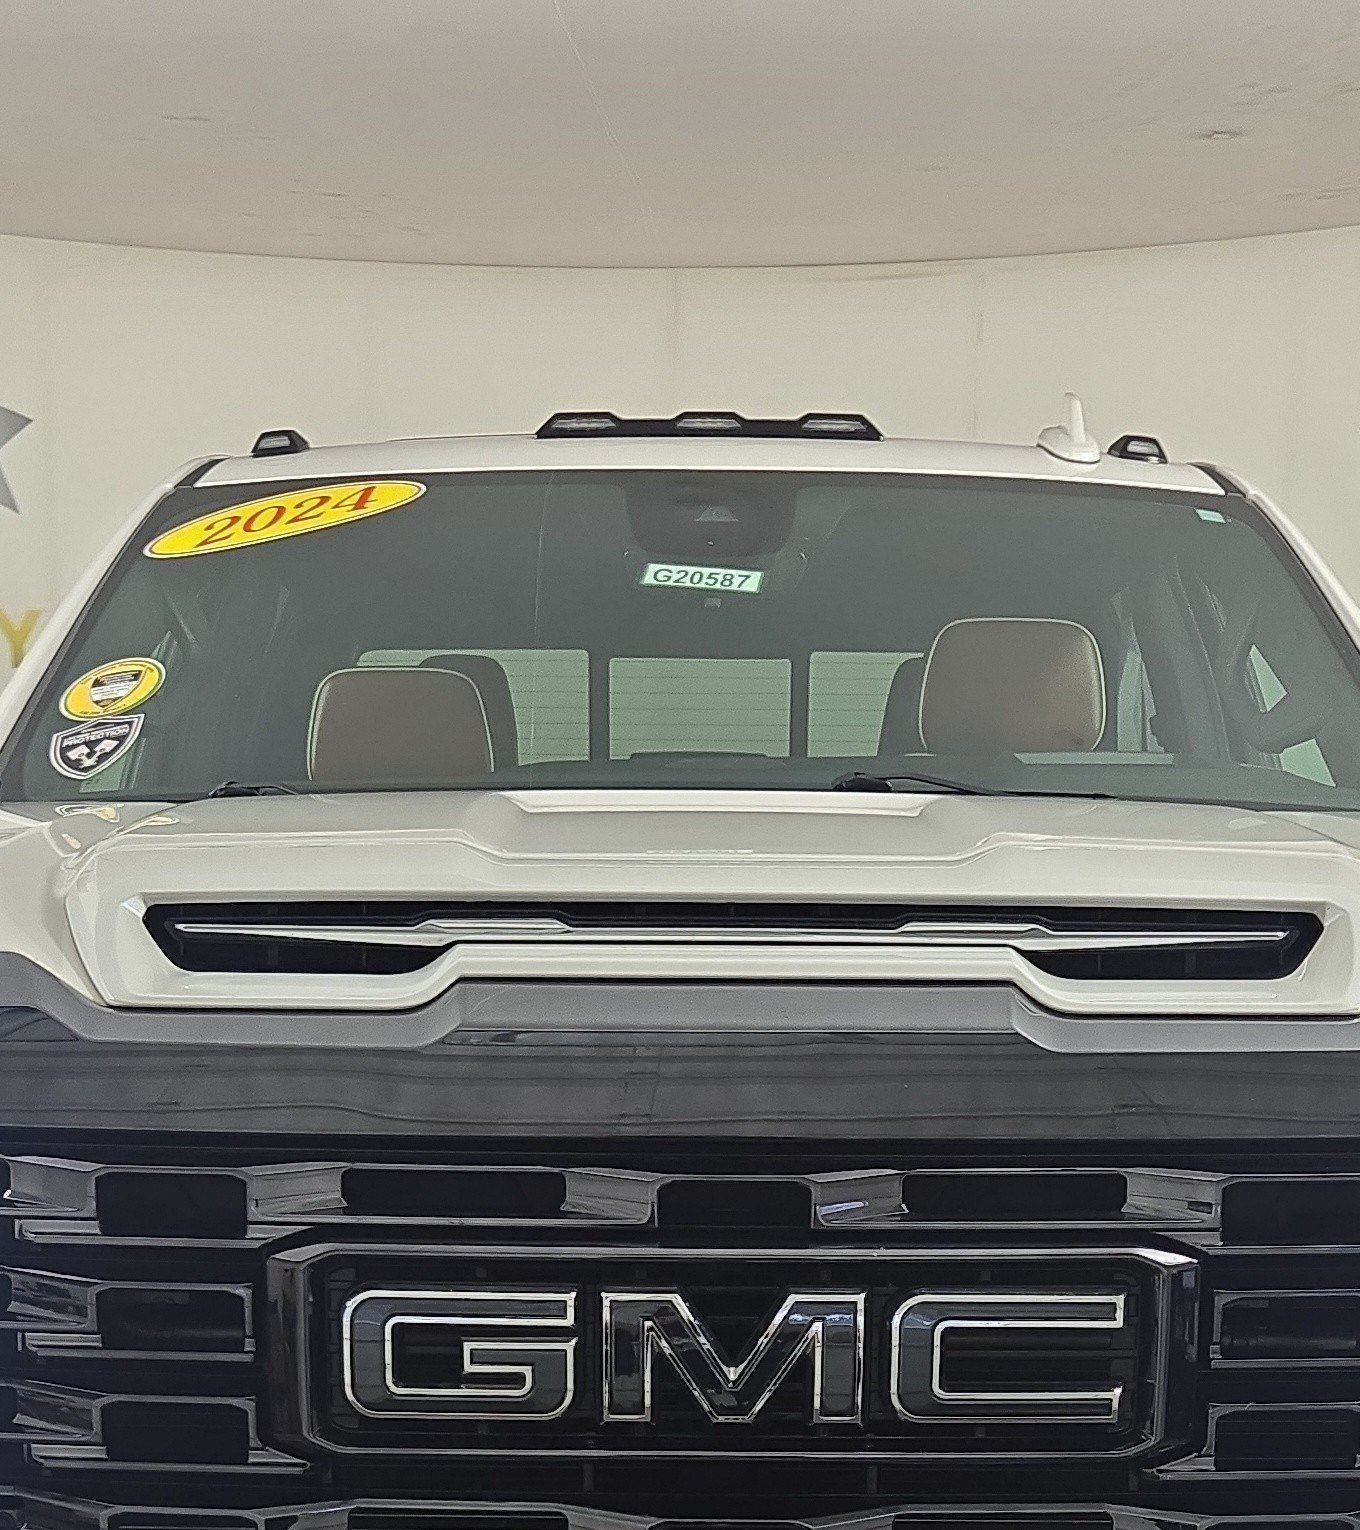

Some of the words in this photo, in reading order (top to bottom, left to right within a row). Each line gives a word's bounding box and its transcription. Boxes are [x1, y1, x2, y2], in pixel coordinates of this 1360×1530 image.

[193, 486, 378, 548] 2024
[652, 567, 752, 589] G20587
[343, 1289, 1126, 1424] GMC
